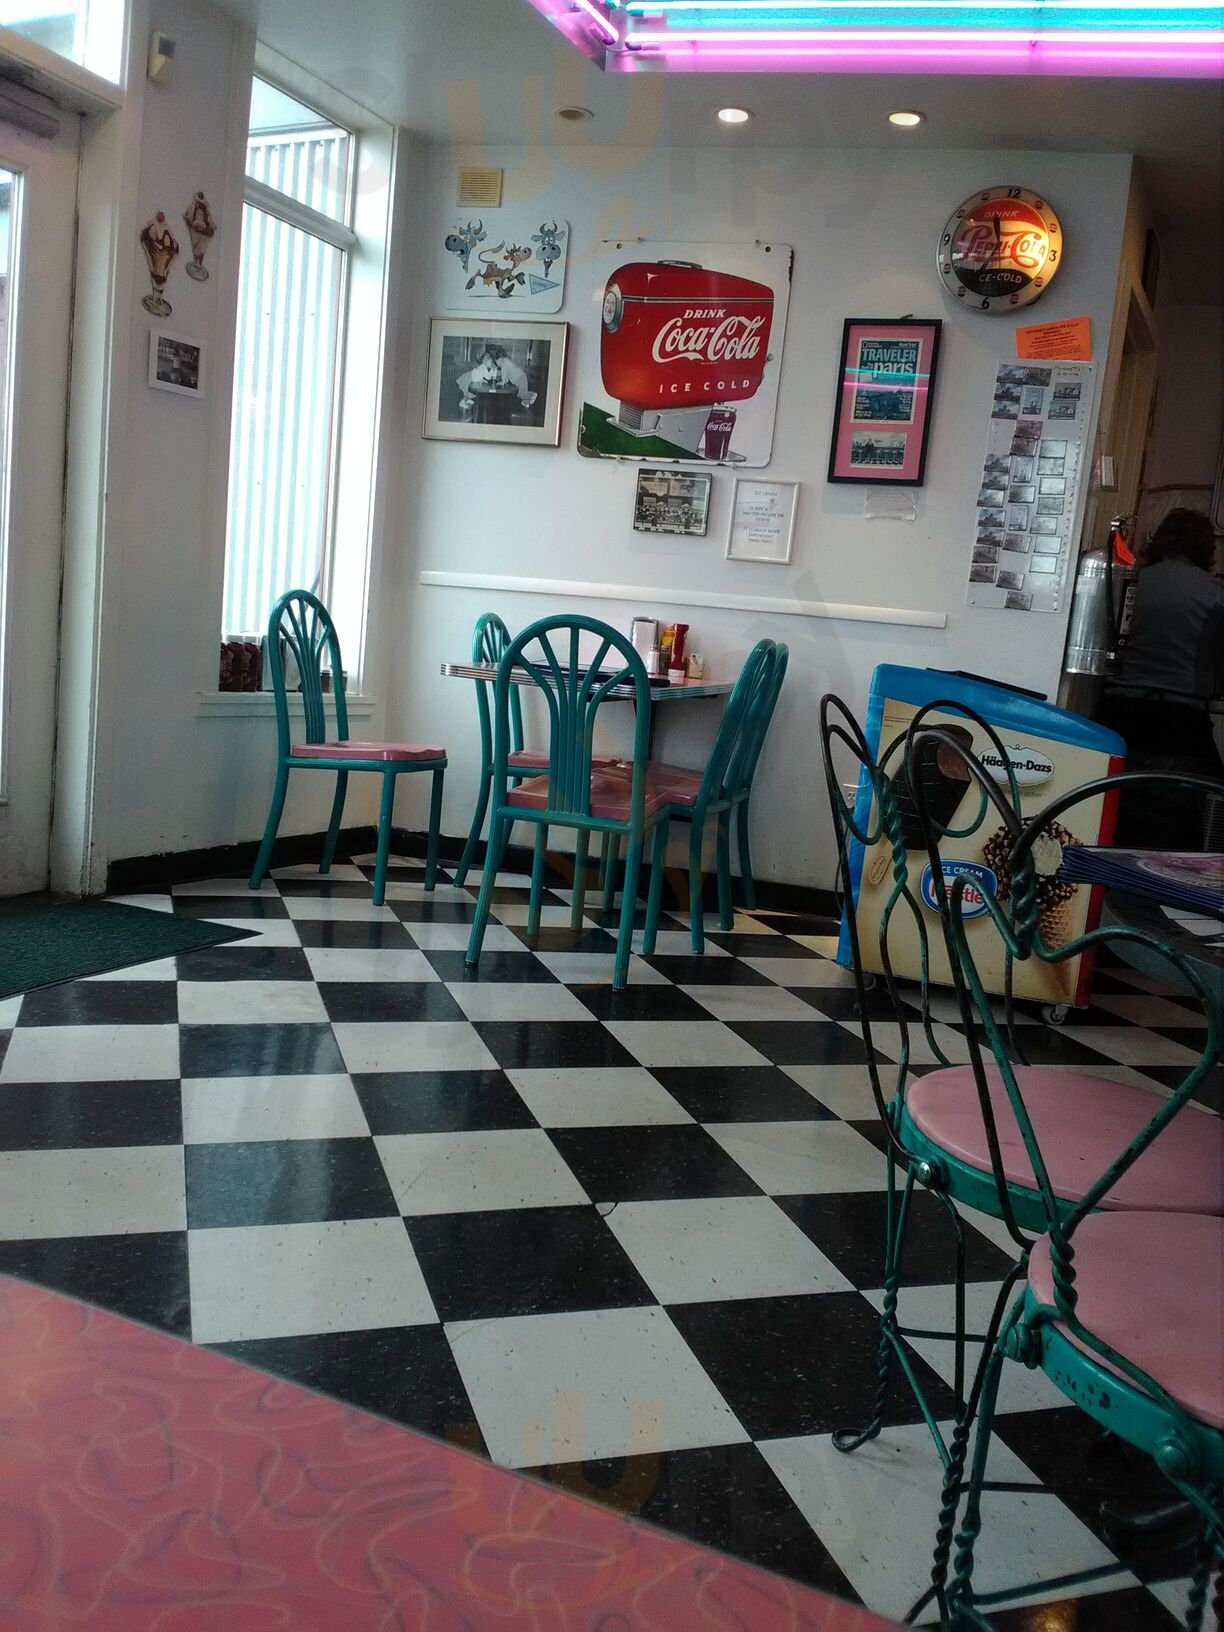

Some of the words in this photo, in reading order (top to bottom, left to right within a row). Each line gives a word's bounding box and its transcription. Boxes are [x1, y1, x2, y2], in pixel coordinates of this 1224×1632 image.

[1007, 188, 1021, 199] 12
[943, 234, 950, 246] 9
[1049, 250, 1057, 262] 3
[977, 271, 1022, 284] CE-COLD
[981, 297, 990, 309] 6
[683, 309, 727, 319] DRINK
[652, 315, 766, 363] Coca-Cola
[862, 349, 918, 362] TRAVELER
[873, 360, 914, 378] paris
[659, 383, 691, 394] ICE
[703, 380, 750, 391] COLD
[706, 421, 733, 432] Coca-Cola
[941, 866, 951, 874] CE
